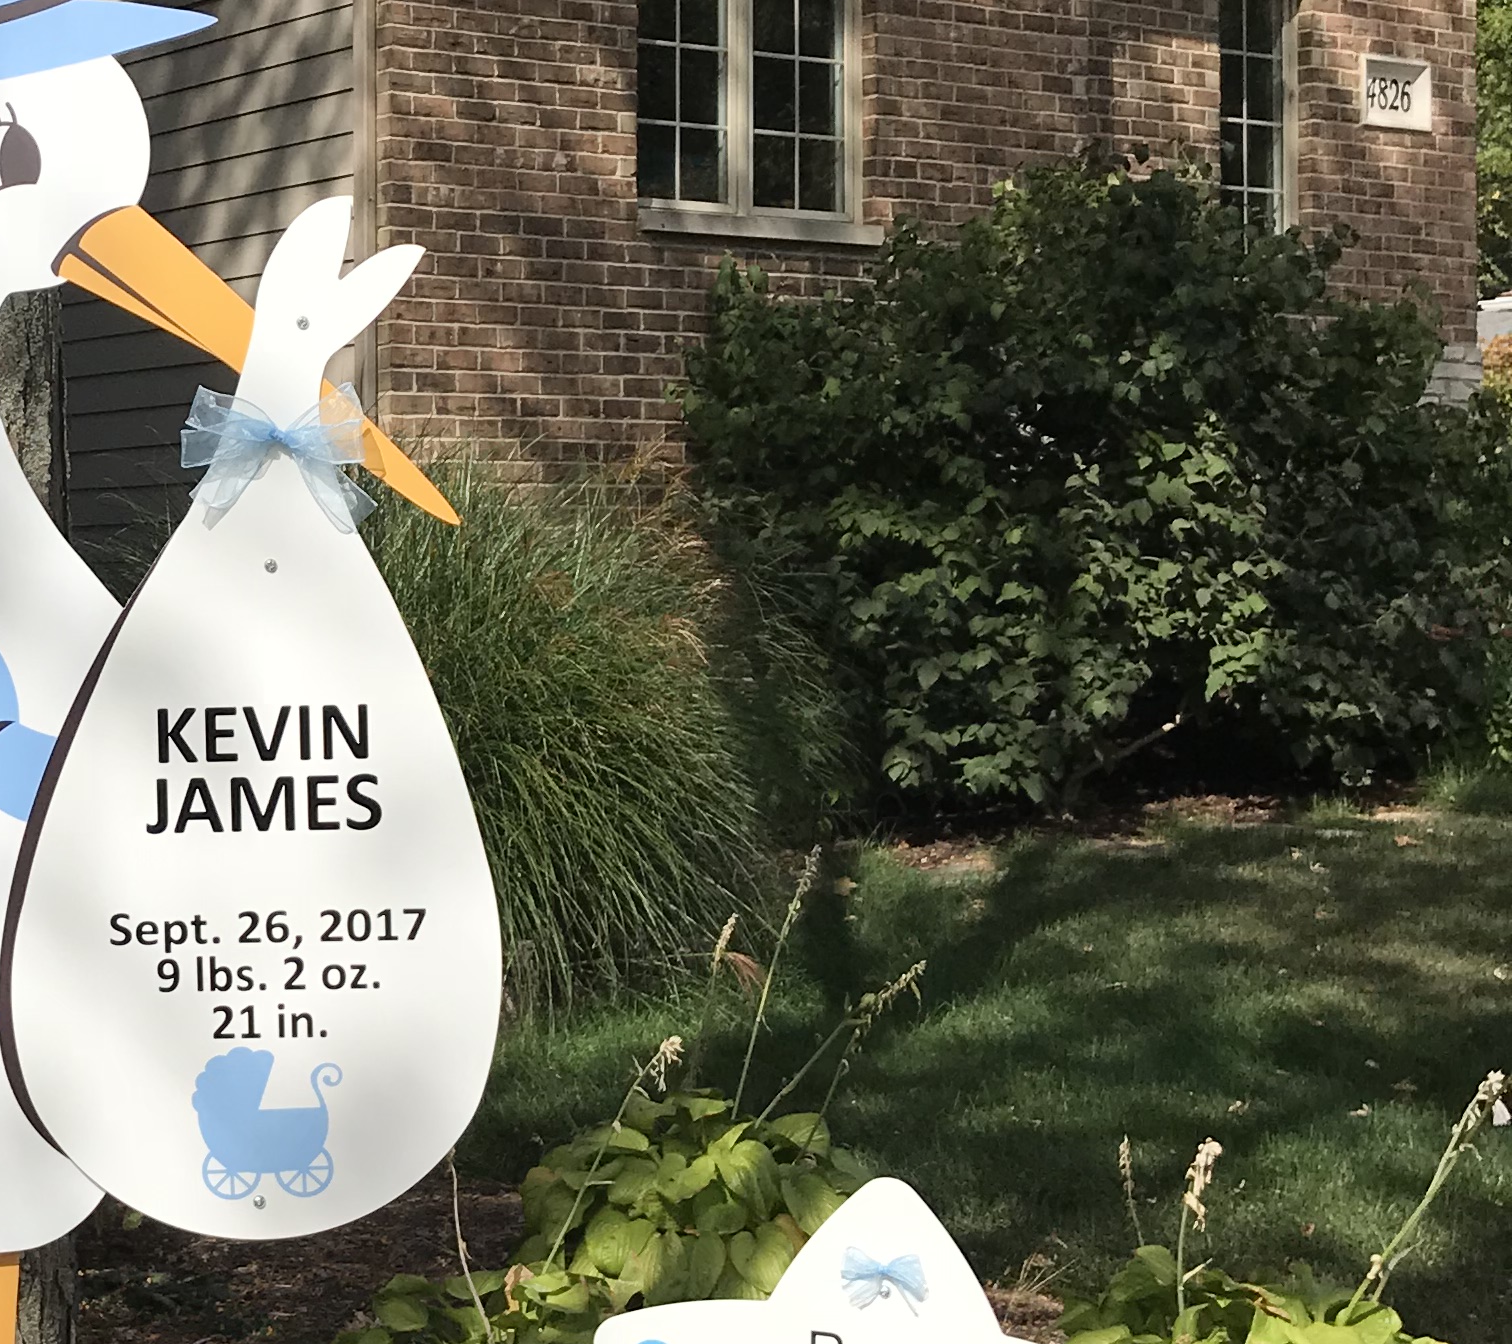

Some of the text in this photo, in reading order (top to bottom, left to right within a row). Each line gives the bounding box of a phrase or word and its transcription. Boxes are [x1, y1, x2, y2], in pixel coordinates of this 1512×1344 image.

[1367, 76, 1412, 113] 4826
[157, 704, 369, 764] KEVIN
[146, 773, 382, 835] JAMES
[109, 908, 426, 954] Sept. 26, 2017
[157, 956, 380, 993] 9 lbs. 2 oz.
[213, 1003, 327, 1040] 21 in.
